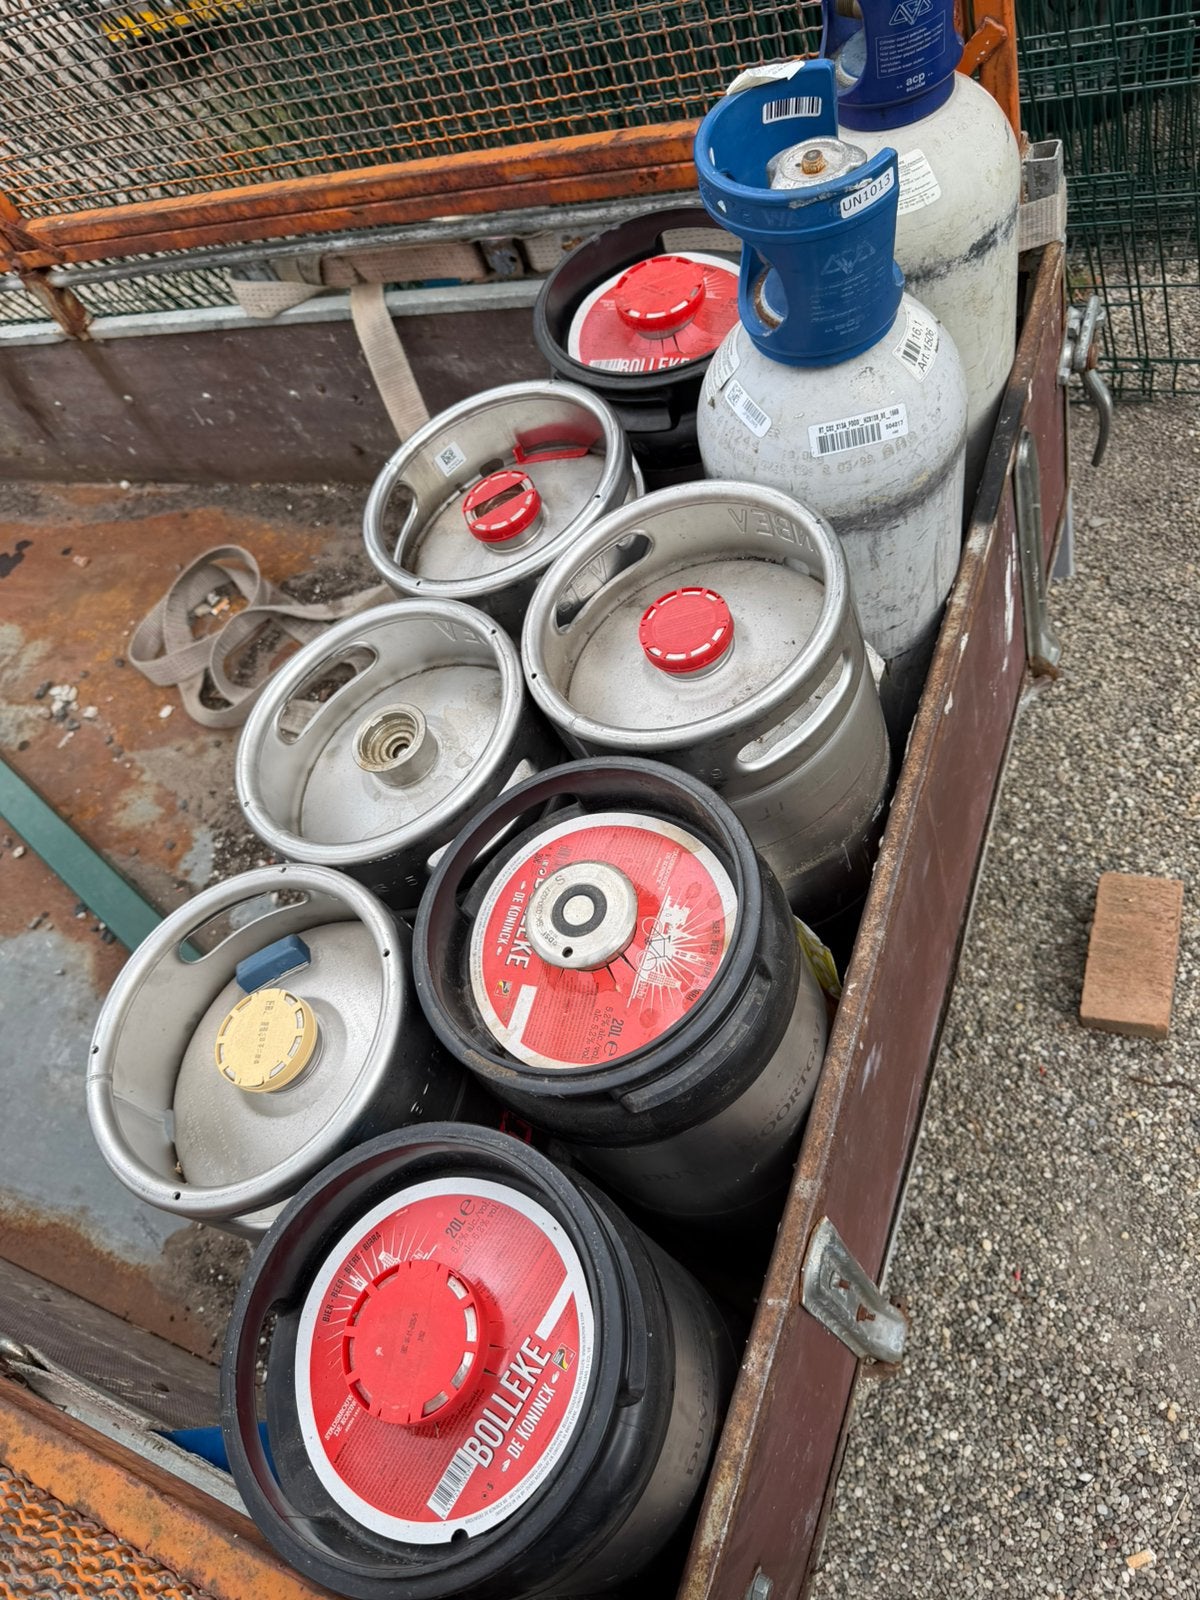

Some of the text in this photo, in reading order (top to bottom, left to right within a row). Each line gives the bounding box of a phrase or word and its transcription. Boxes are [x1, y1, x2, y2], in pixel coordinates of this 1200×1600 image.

[842, 173, 892, 212] UN1013
[512, 892, 525, 906] DE
[497, 905, 521, 946] KONINCK
[611, 1019, 625, 1037] 20L
[445, 1217, 467, 1239] 20L
[322, 1302, 335, 1323] BIER
[331, 1277, 346, 1299] BEER
[362, 1231, 382, 1252] BIRRA
[464, 1336, 551, 1468] BOLLEKE
[515, 1382, 557, 1441] KONINCK
[507, 1437, 525, 1459] DE
